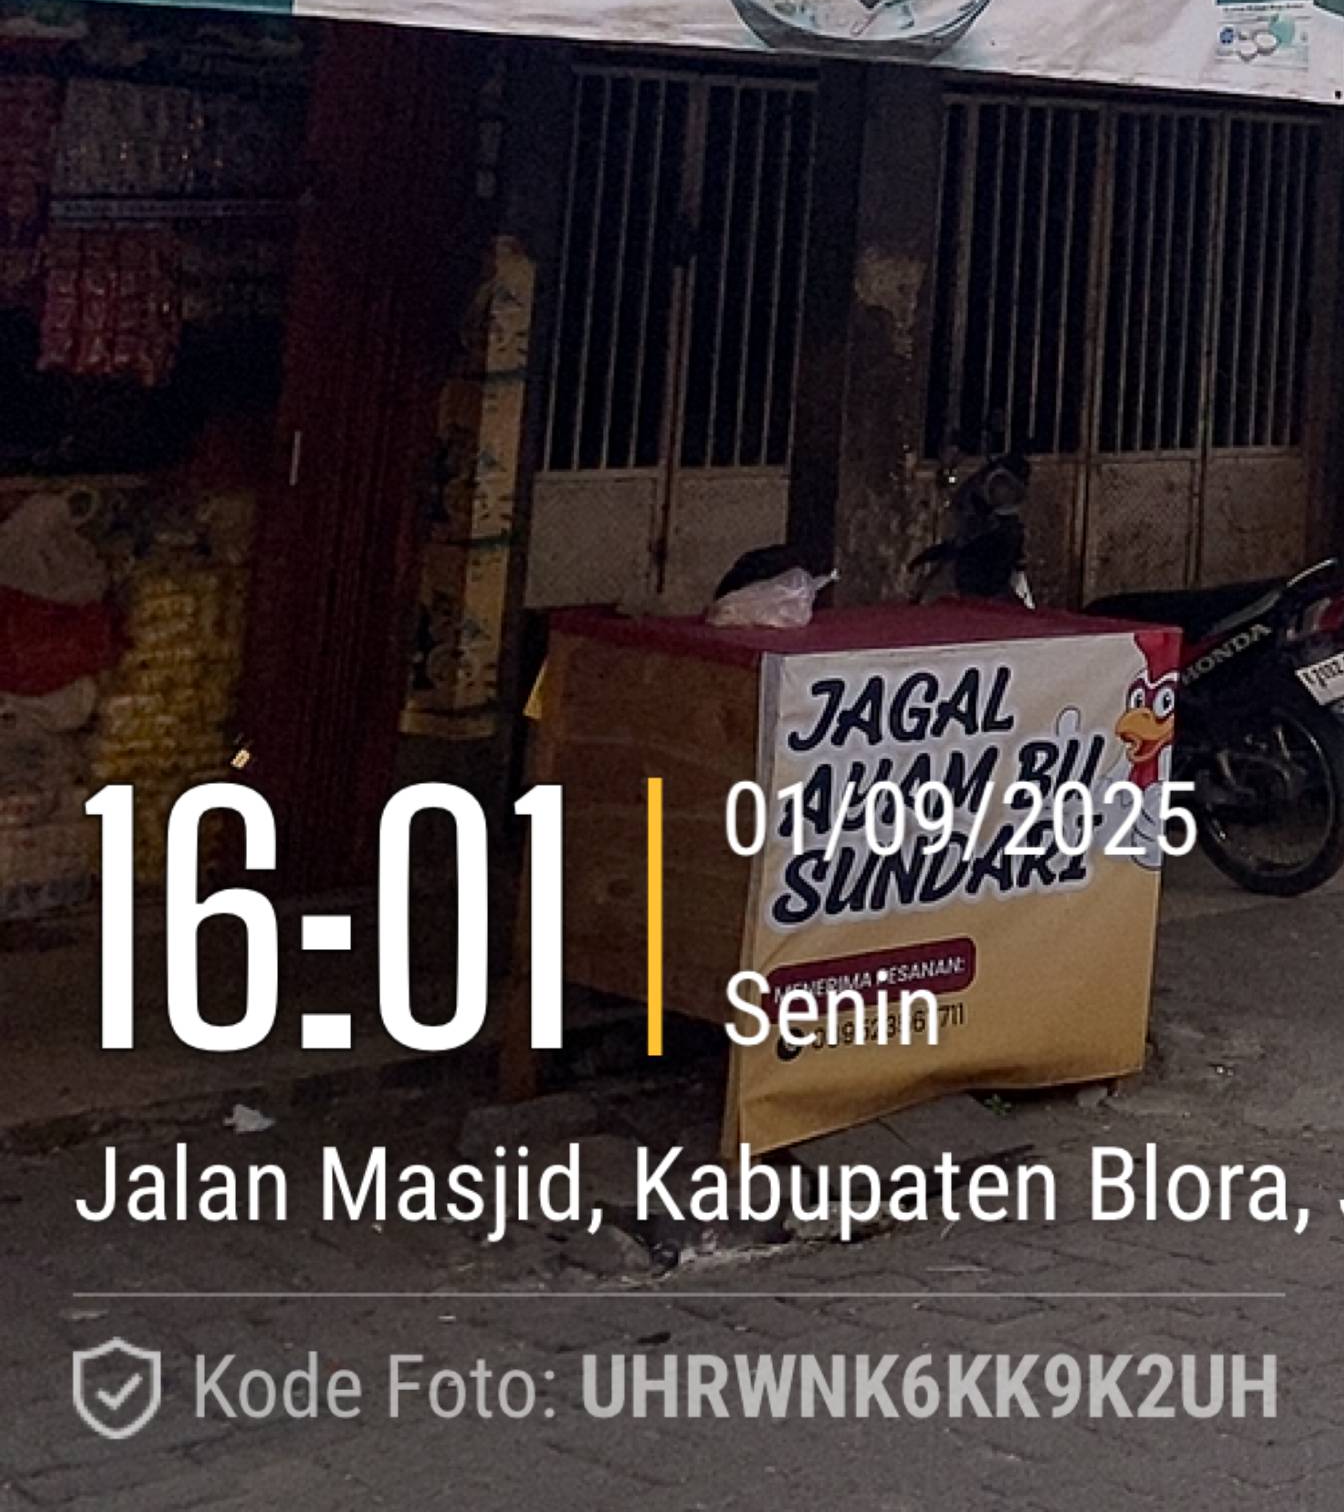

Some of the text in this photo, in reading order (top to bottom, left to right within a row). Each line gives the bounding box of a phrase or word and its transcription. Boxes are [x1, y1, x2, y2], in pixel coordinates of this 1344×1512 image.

[1182, 623, 1272, 686] HONDA
[787, 666, 1015, 751] JAGAL
[779, 744, 999, 838] AYAM
[771, 814, 1104, 924] SUNDARI
